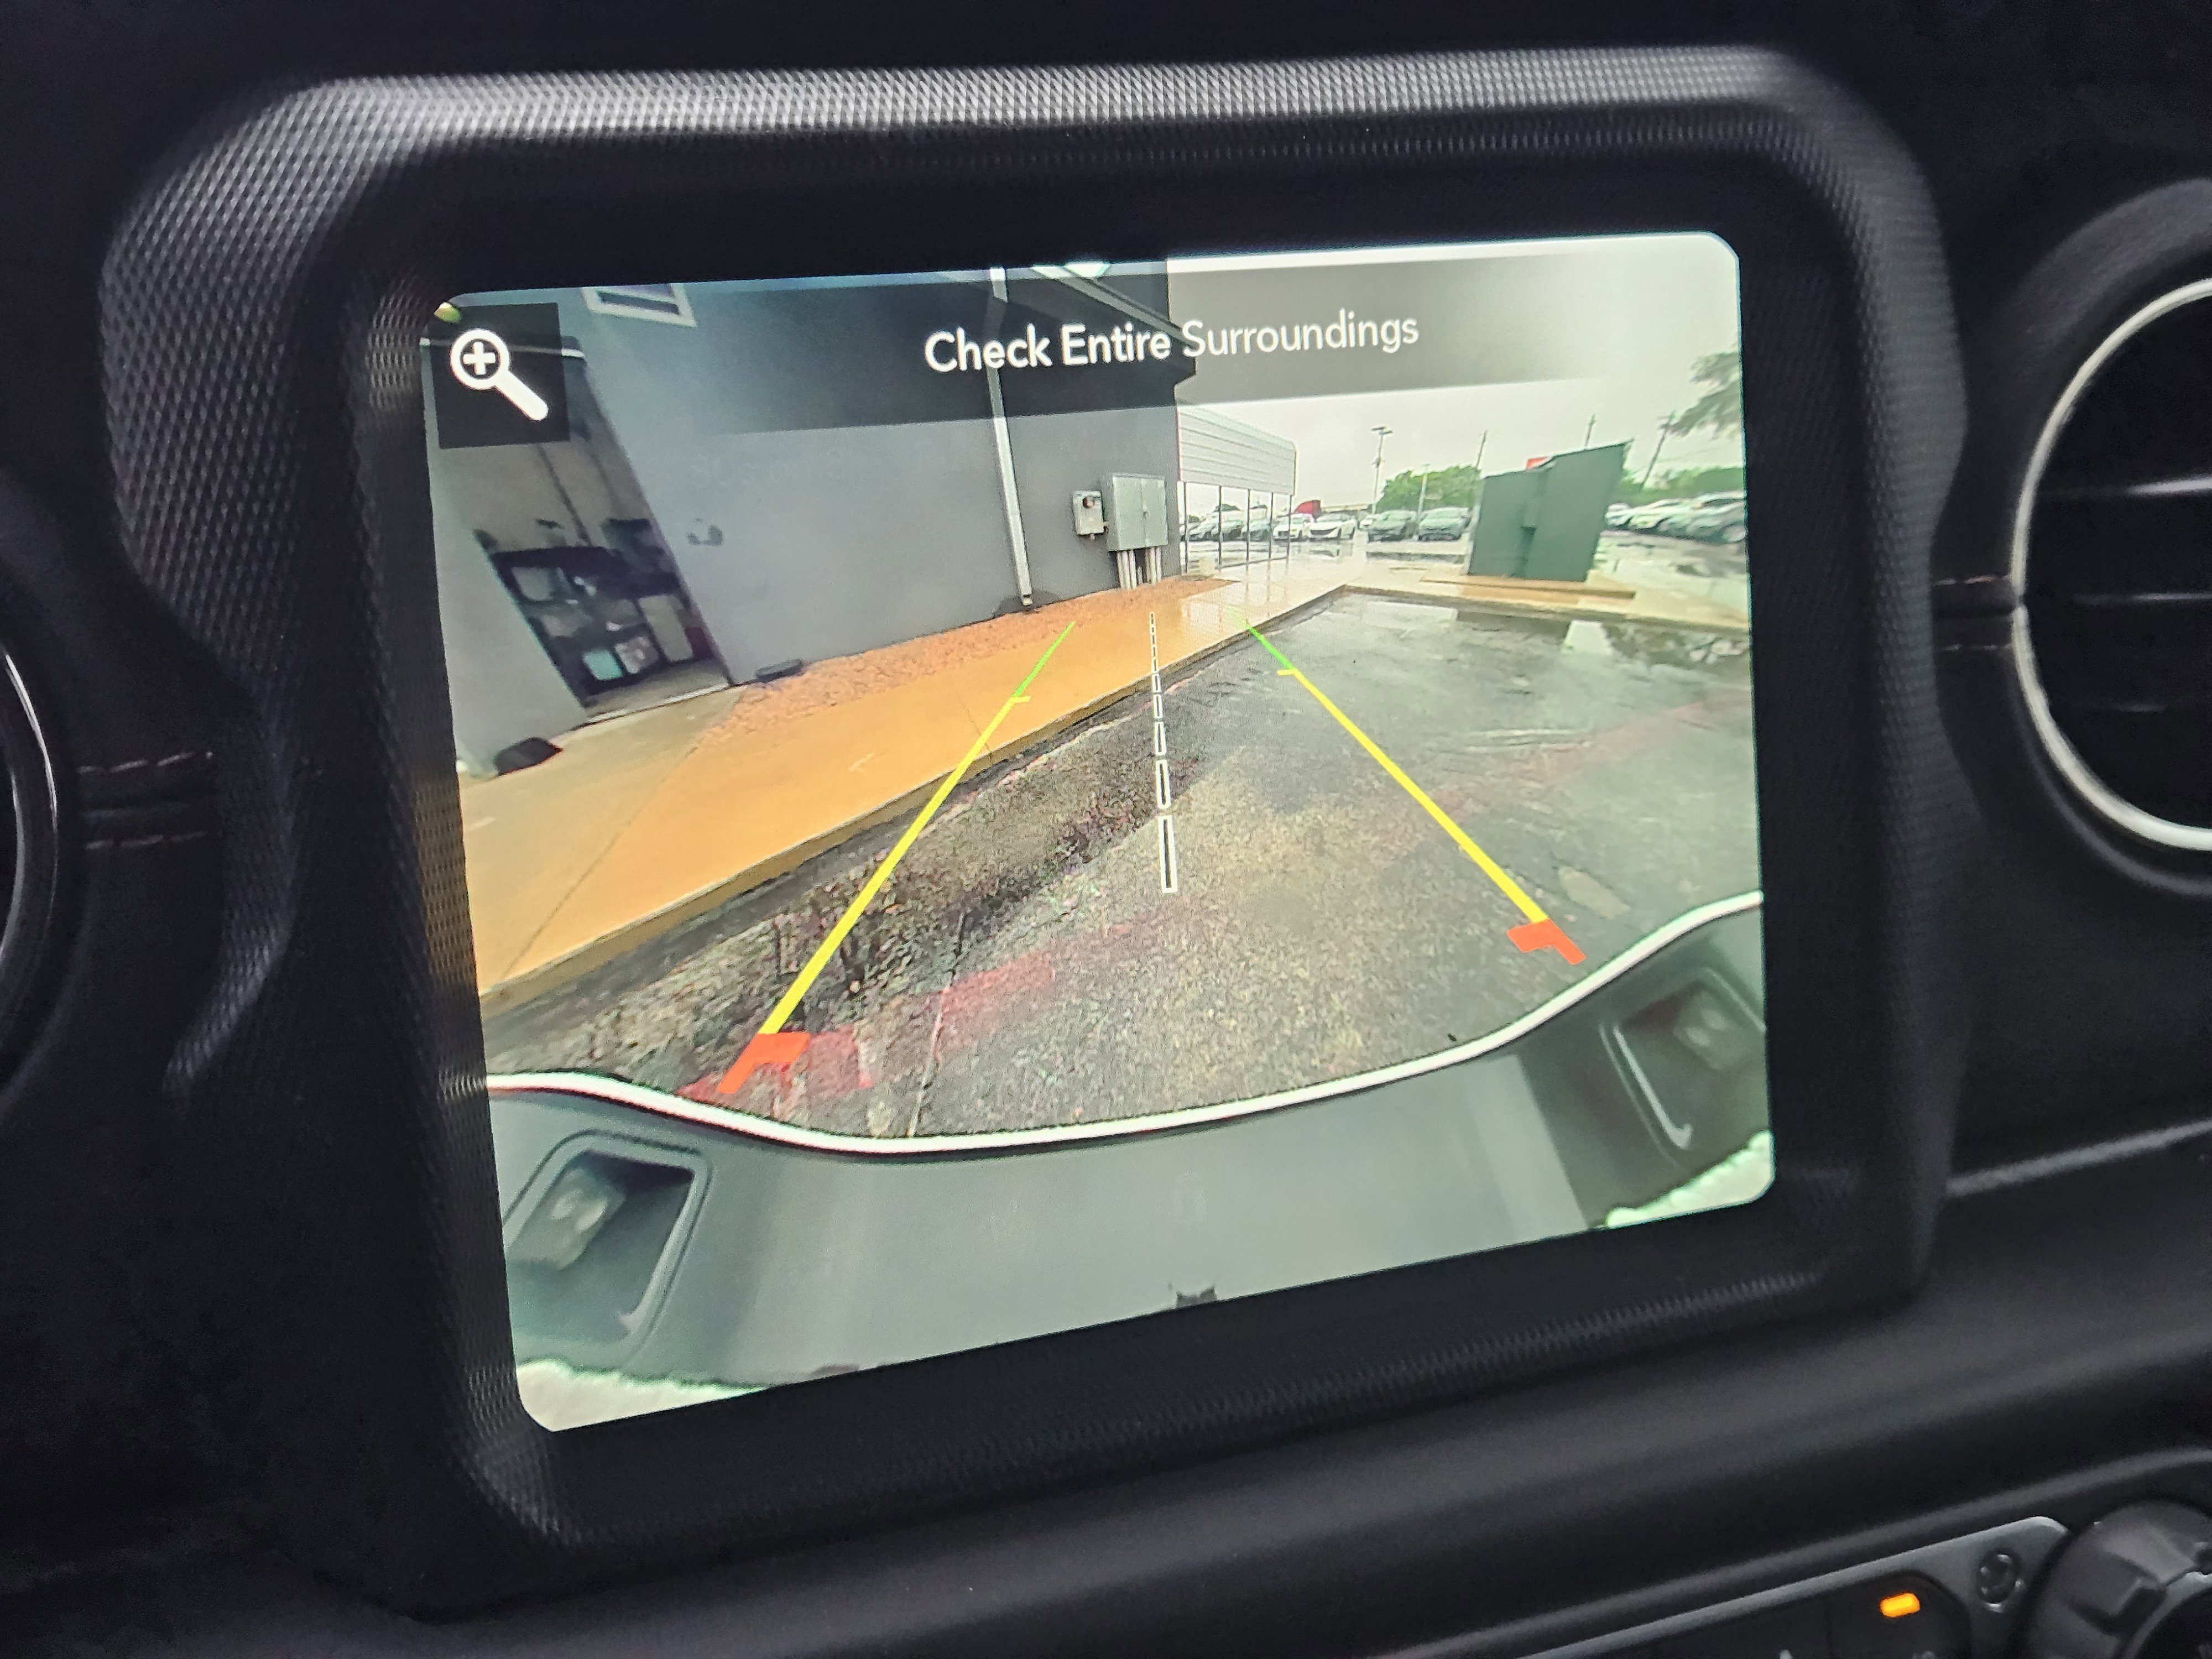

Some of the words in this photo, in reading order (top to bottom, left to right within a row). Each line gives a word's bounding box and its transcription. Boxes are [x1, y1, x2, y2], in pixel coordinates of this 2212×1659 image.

[925, 322, 1052, 372] Check
[1061, 322, 1171, 366] Entire
[1182, 309, 1419, 354] Surroundings
